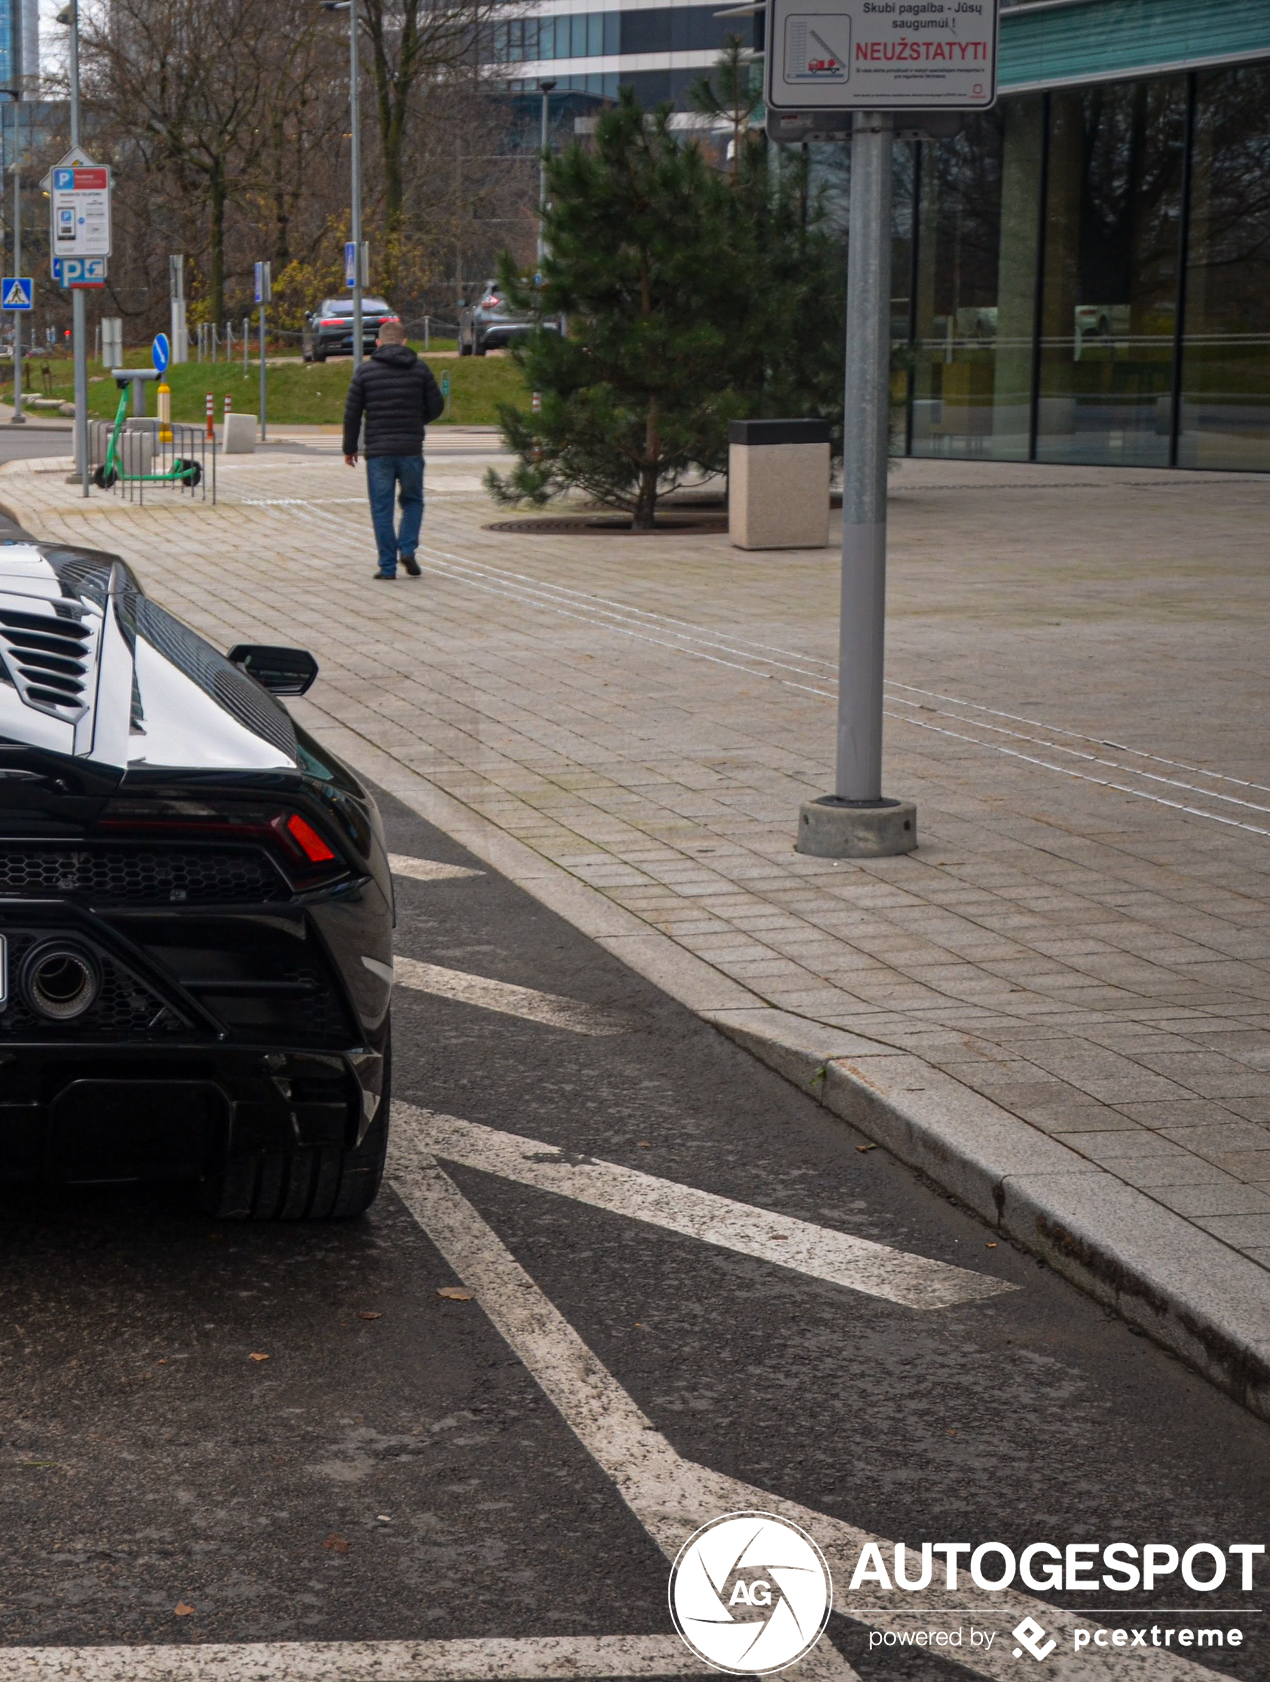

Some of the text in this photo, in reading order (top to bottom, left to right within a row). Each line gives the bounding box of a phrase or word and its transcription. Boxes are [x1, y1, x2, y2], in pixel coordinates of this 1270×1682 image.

[863, 2, 895, 13] Skubi
[898, 2, 944, 15] pagalba
[954, 2, 982, 15] Jūsų
[892, 18, 949, 31] saugumui
[855, 37, 988, 60] NEUŽSTATYTI
[59, 172, 70, 186] P
[62, 259, 82, 287] P
